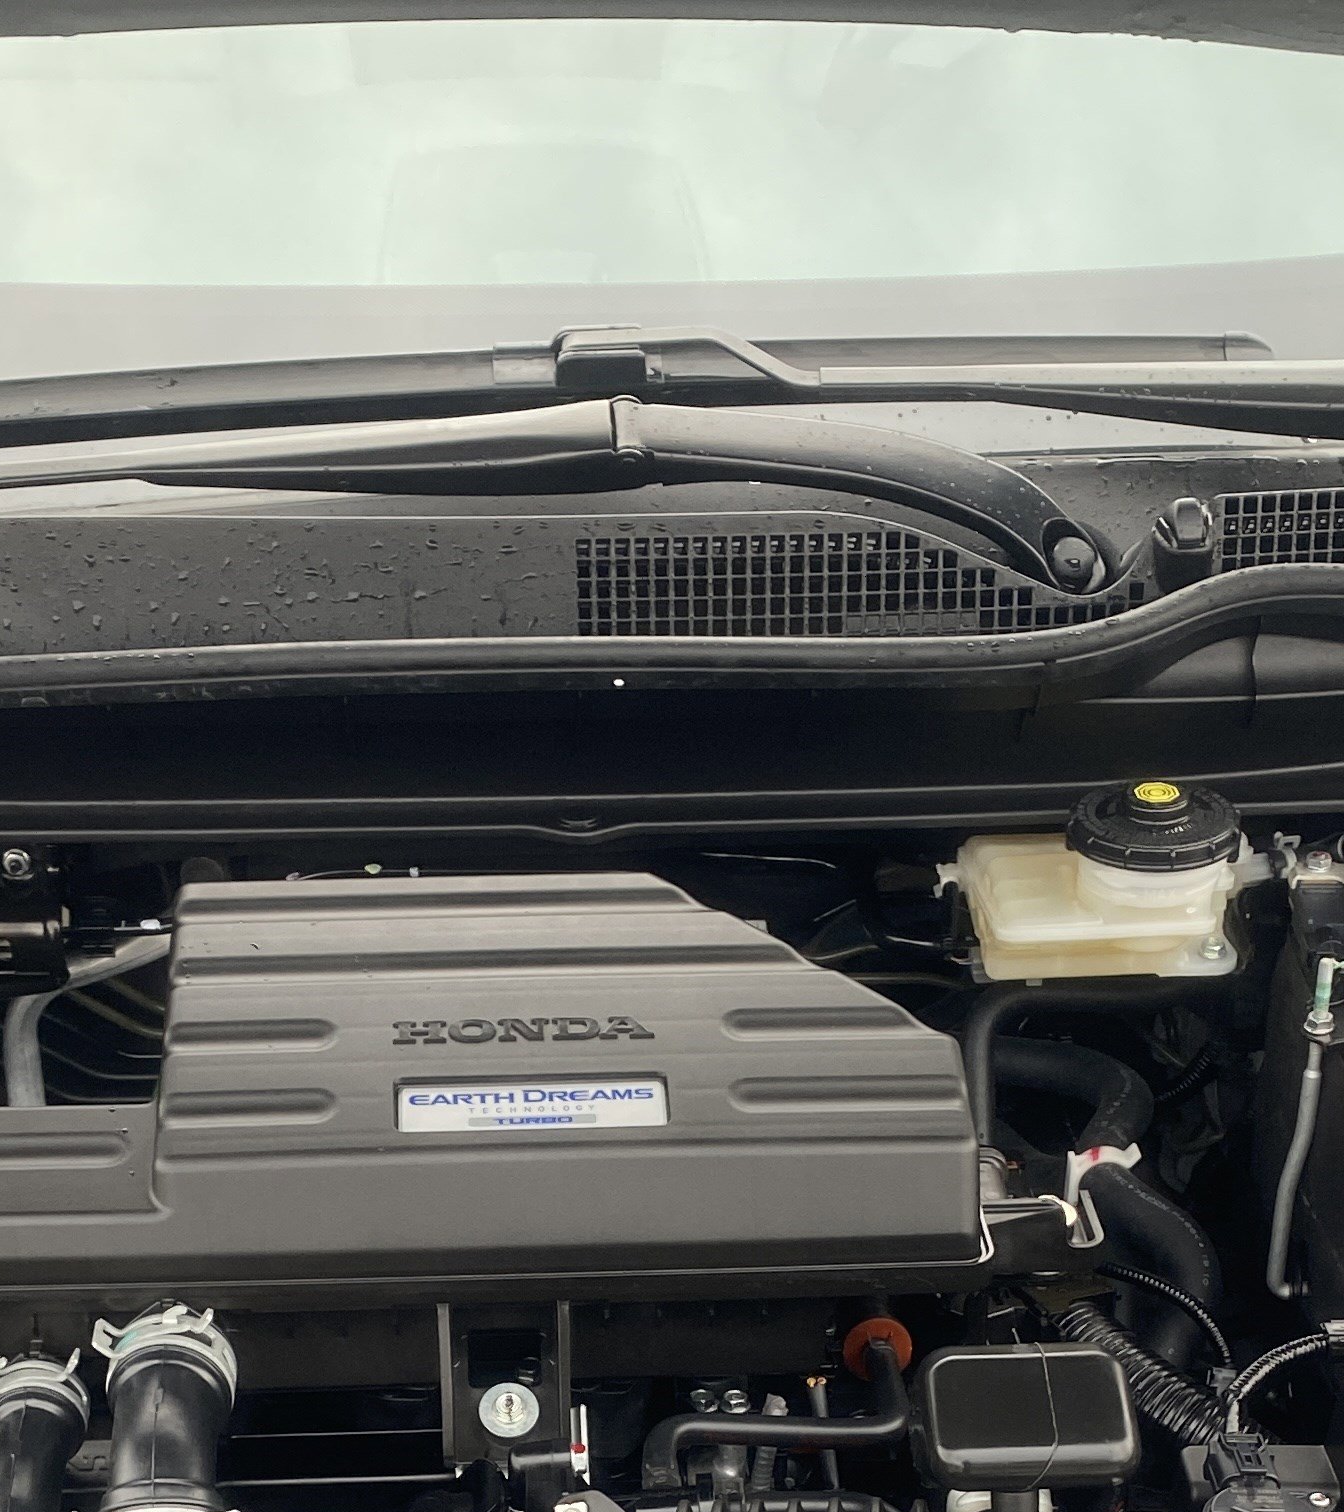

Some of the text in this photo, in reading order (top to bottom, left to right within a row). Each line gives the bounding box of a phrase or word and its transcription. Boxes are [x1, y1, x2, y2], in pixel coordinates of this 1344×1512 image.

[392, 1015, 655, 1045] HONDA
[408, 1087, 654, 1106] EARTH DREAMS
[467, 1104, 596, 1114] TECHNOLOGY
[492, 1116, 573, 1126] TURBO
